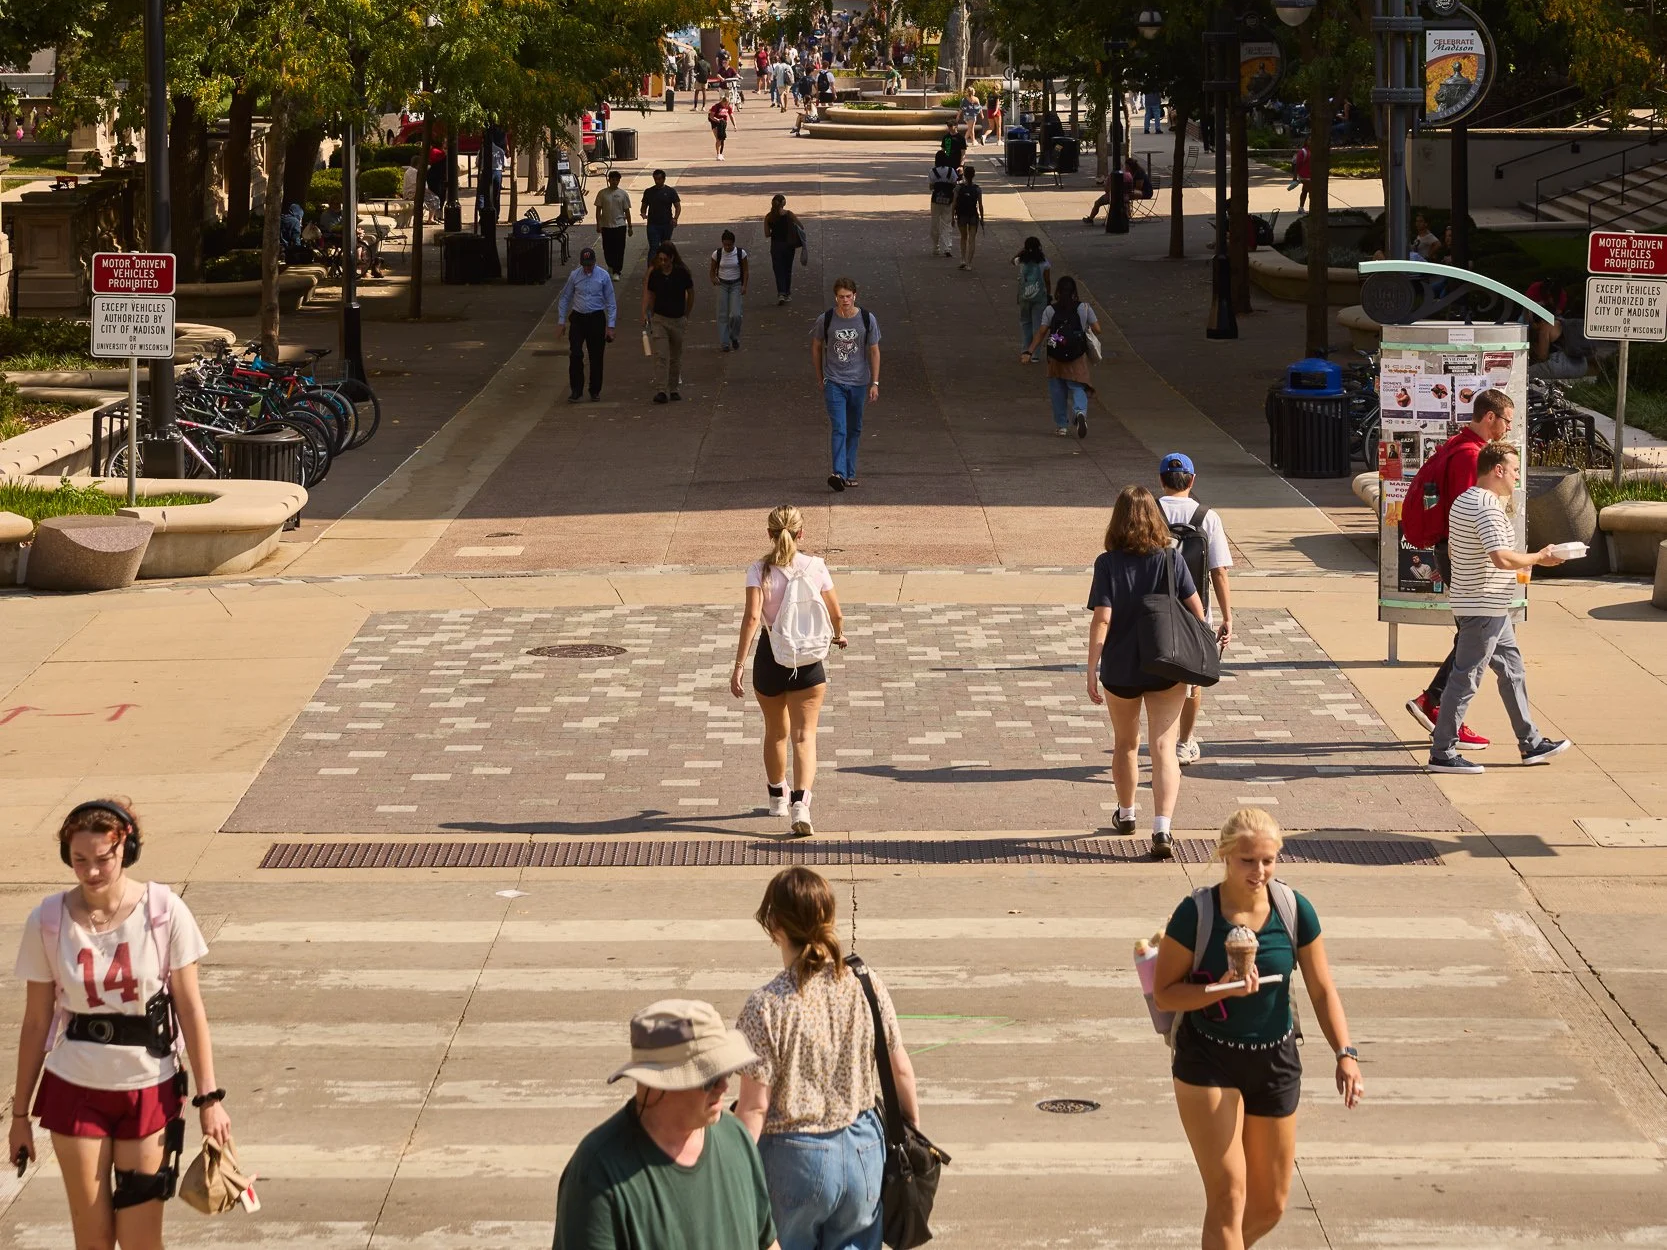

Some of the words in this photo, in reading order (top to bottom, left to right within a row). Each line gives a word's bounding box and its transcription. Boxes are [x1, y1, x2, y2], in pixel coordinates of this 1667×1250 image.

[1434, 38, 1474, 46] CELEBRATE
[1432, 43, 1473, 52] Madison
[1599, 238, 1627, 248] MOTOR
[1632, 240, 1663, 250] DRIVEN
[1610, 249, 1651, 259] VEHICLES
[102, 259, 130, 268] MOTOR
[136, 260, 166, 268] DRIVEN
[1604, 259, 1655, 269] PROHIBITED
[113, 269, 154, 278] VEHICLES
[108, 279, 158, 288] PROHIBITED
[1596, 284, 1622, 294] EXCEPT
[1626, 286, 1660, 296] VEHICLES
[1598, 296, 1644, 306] AUTHORIZED
[1648, 298, 1657, 306] BY
[102, 302, 128, 312] EXCEPT
[132, 303, 166, 312] VEHICLES
[1594, 306, 1610, 316] CITY
[1614, 308, 1624, 316] OF
[1628, 308, 1660, 318] MADISON
[104, 314, 150, 323] AUTHORIZED
[154, 315, 162, 323] BY
[101, 325, 116, 334] CITY
[120, 326, 129, 334] OF
[133, 326, 166, 334] MADISON
[76, 942, 140, 1008] 14
